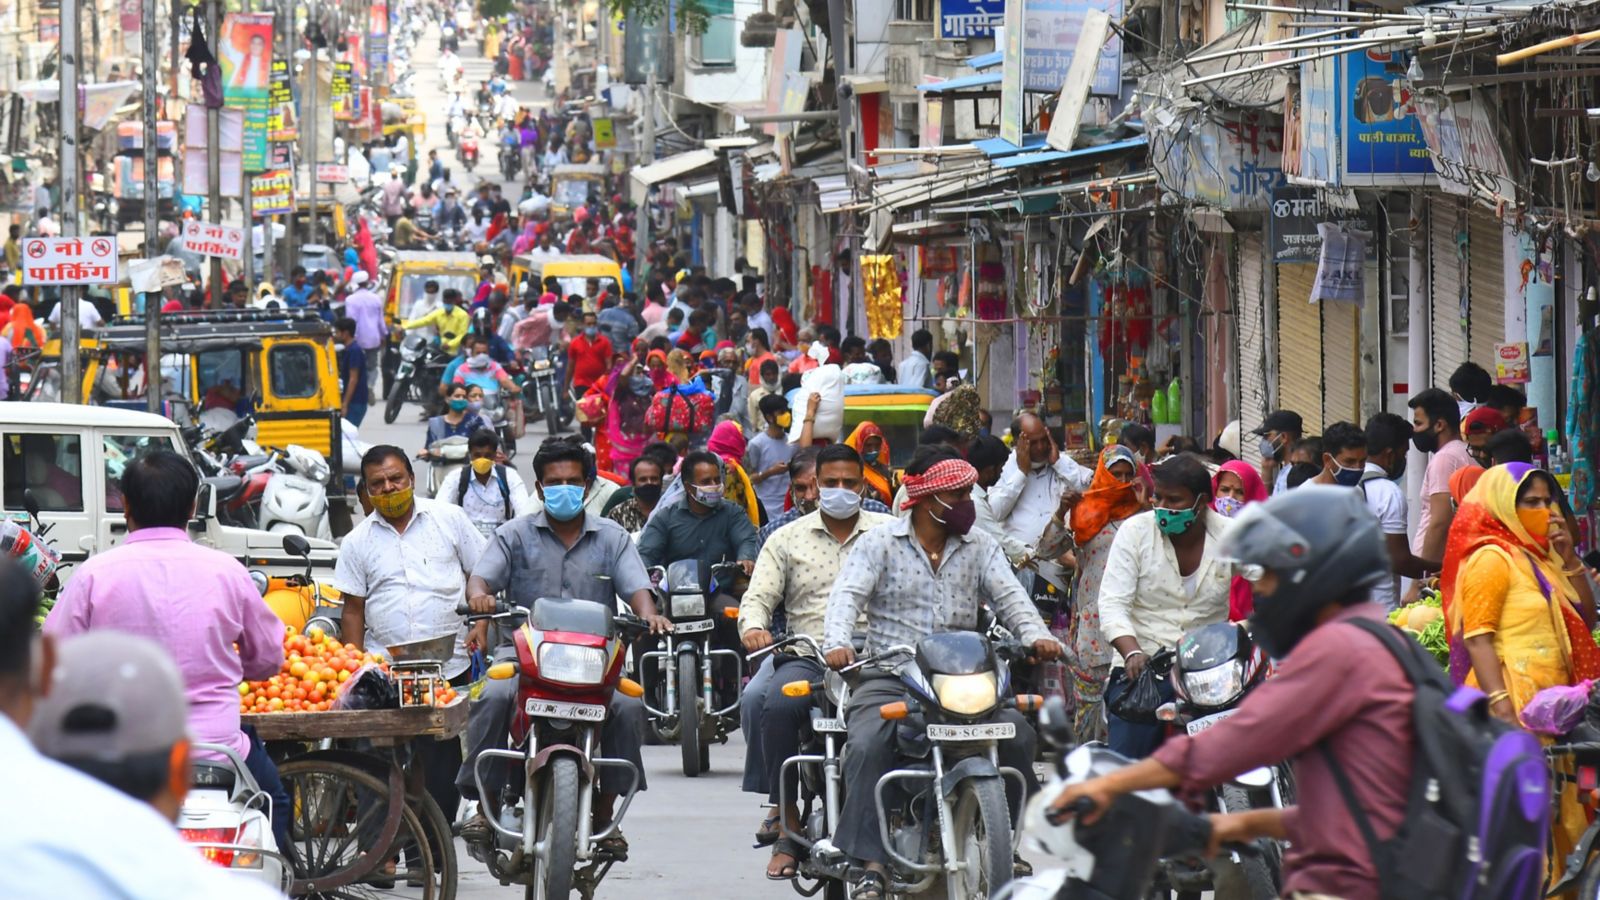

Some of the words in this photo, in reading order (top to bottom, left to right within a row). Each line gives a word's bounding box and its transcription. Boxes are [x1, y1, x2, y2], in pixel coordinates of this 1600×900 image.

[1358, 131, 1384, 143] पाली
[205, 226, 224, 239] नो
[54, 238, 84, 256] नो
[185, 240, 238, 257] पार्किंग
[28, 261, 110, 280] पार्किंग
